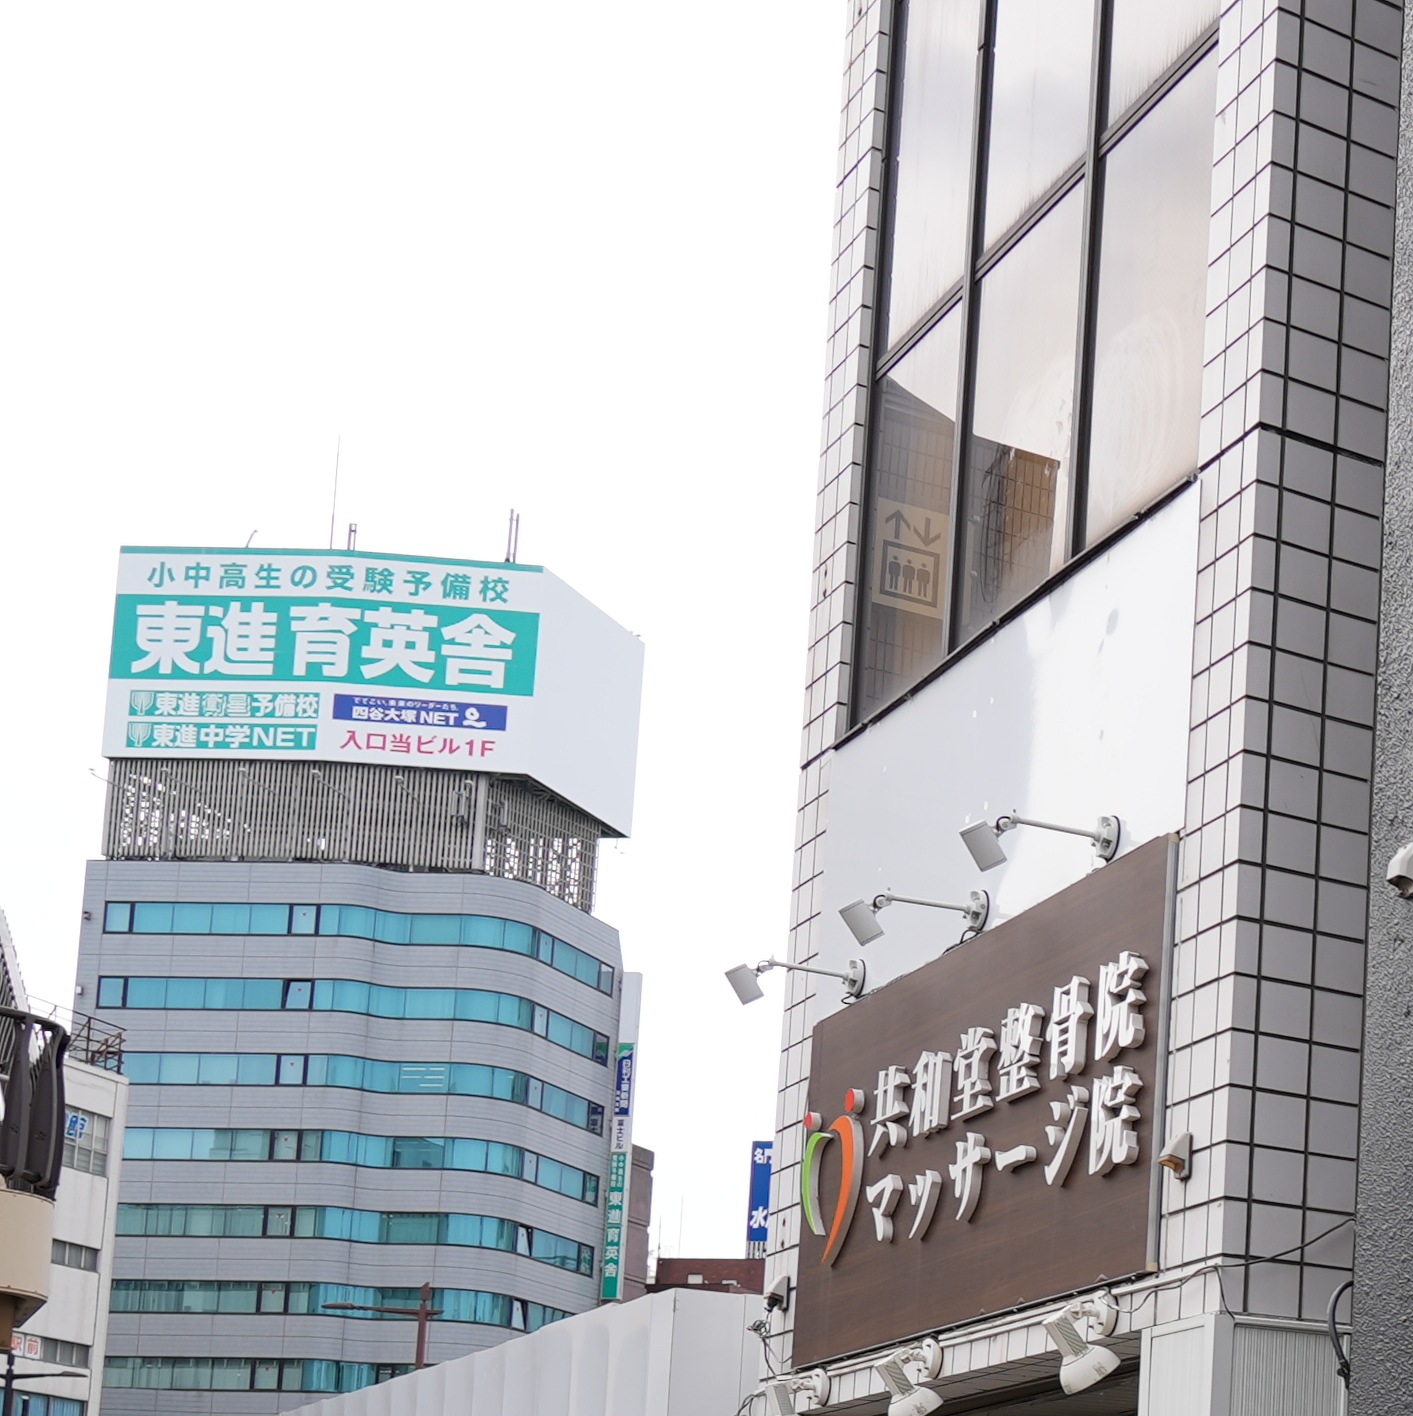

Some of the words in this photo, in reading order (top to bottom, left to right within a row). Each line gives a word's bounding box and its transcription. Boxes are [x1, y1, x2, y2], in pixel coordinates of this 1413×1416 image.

[148, 562, 510, 604] 小中高生の受験予備校
[130, 601, 517, 688] 東進育英舎
[152, 723, 316, 749] 東進中学NET
[154, 692, 319, 718] 東進衛星予備校
[868, 950, 1149, 1158] 共和堂整骨院
[866, 1064, 1144, 1243] マッサージ院
[604, 1191, 622, 1278] 東進育英舎
